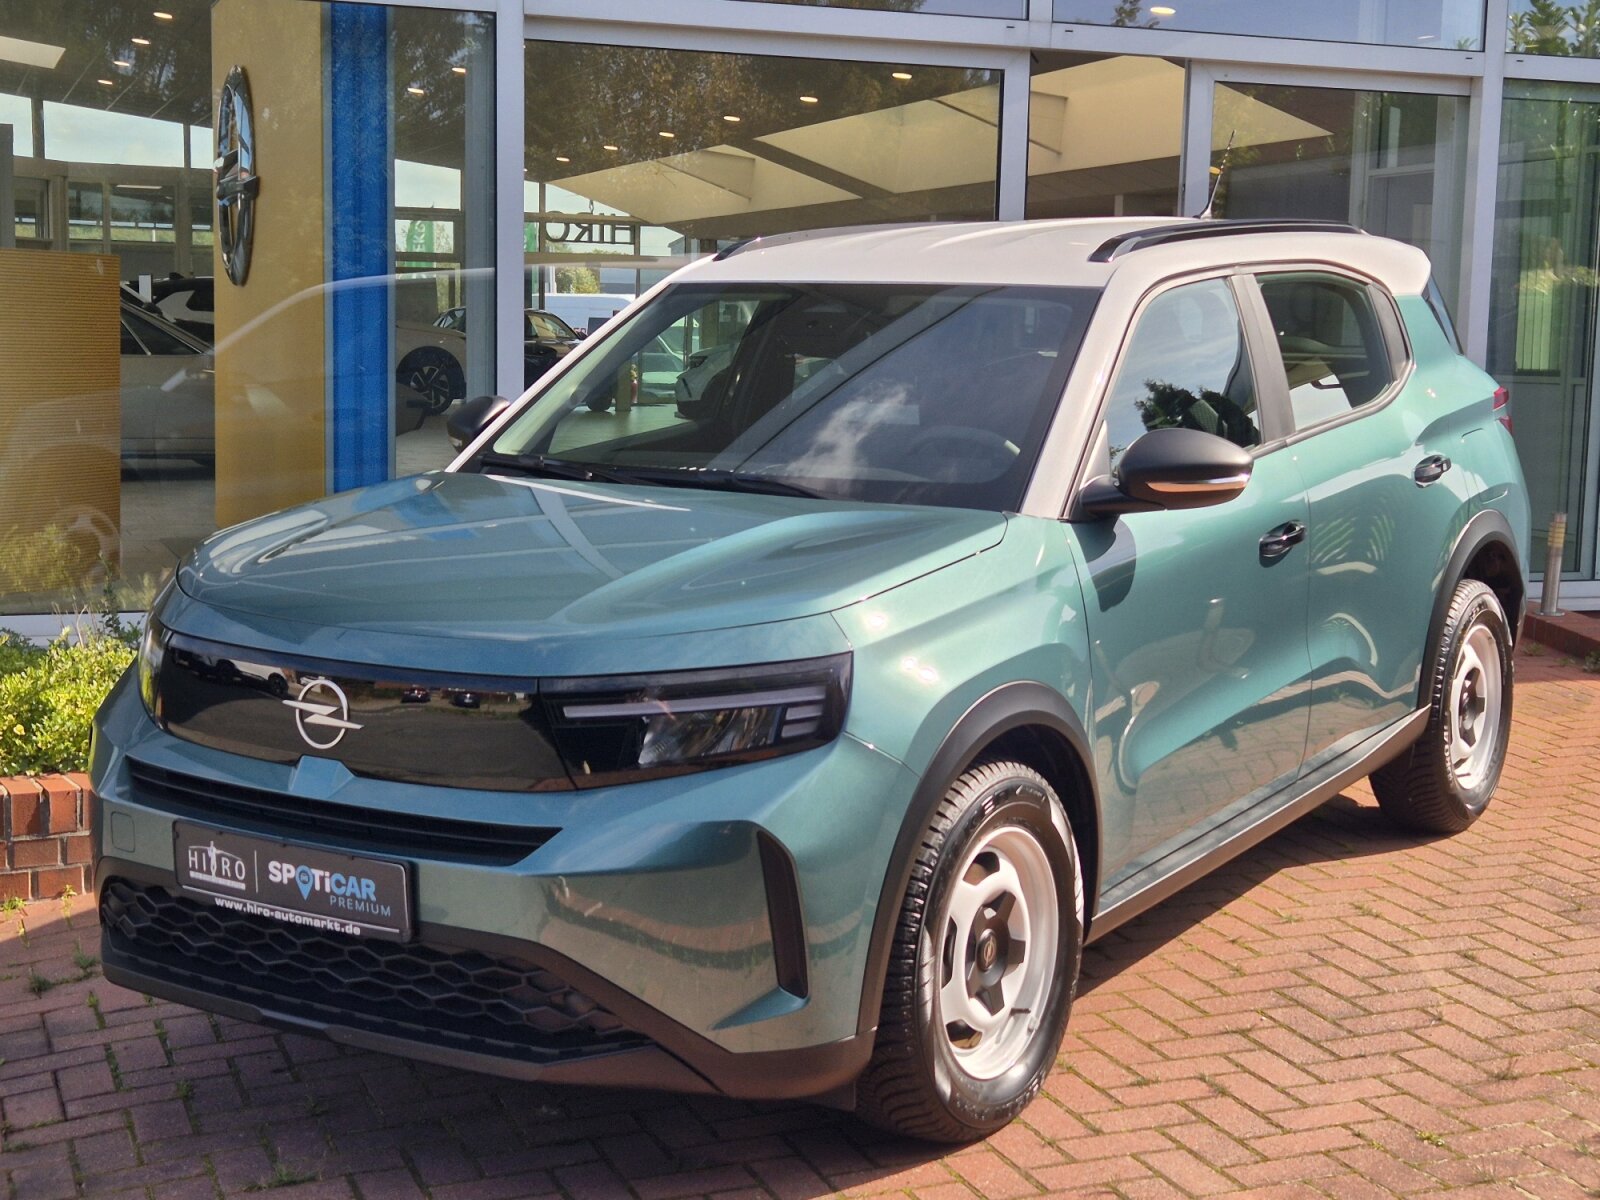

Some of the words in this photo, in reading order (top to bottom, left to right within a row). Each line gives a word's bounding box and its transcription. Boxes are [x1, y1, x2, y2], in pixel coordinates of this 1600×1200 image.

[188, 848, 246, 880] HIRO
[214, 896, 362, 936] www.hiro-automarkt.de
[329, 895, 392, 917] PREMIUM
